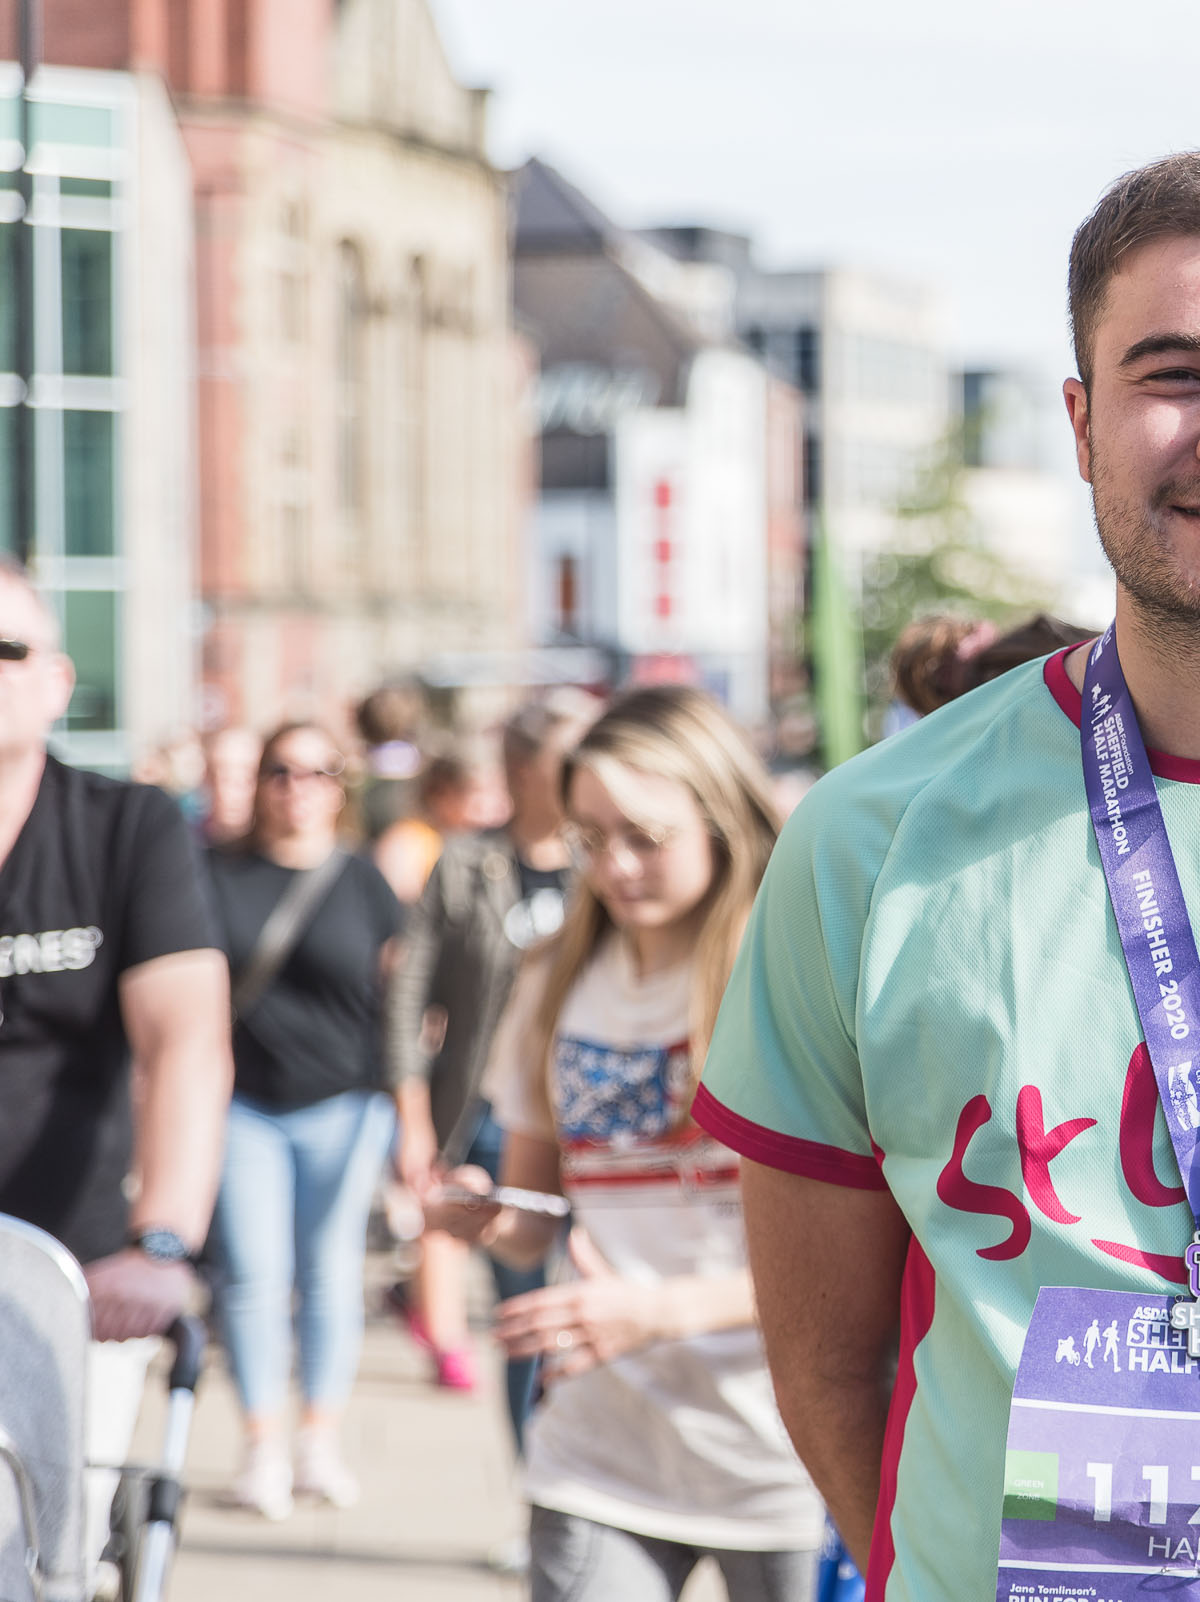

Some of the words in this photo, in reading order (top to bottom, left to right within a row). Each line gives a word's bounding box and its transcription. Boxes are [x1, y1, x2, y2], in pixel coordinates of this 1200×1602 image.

[1092, 724, 1109, 760] HALF
[1104, 716, 1129, 790] SHEFFIELD
[1120, 734, 1135, 775] Foundation
[1099, 760, 1131, 856] MARATHON
[1132, 868, 1174, 978] FINISHER
[1159, 979, 1190, 1040] 2020
[1132, 1306, 1169, 1321] ASDA
[1009, 1583, 1035, 1594] Jane
[1037, 1585, 1097, 1597] Tomlinson's
